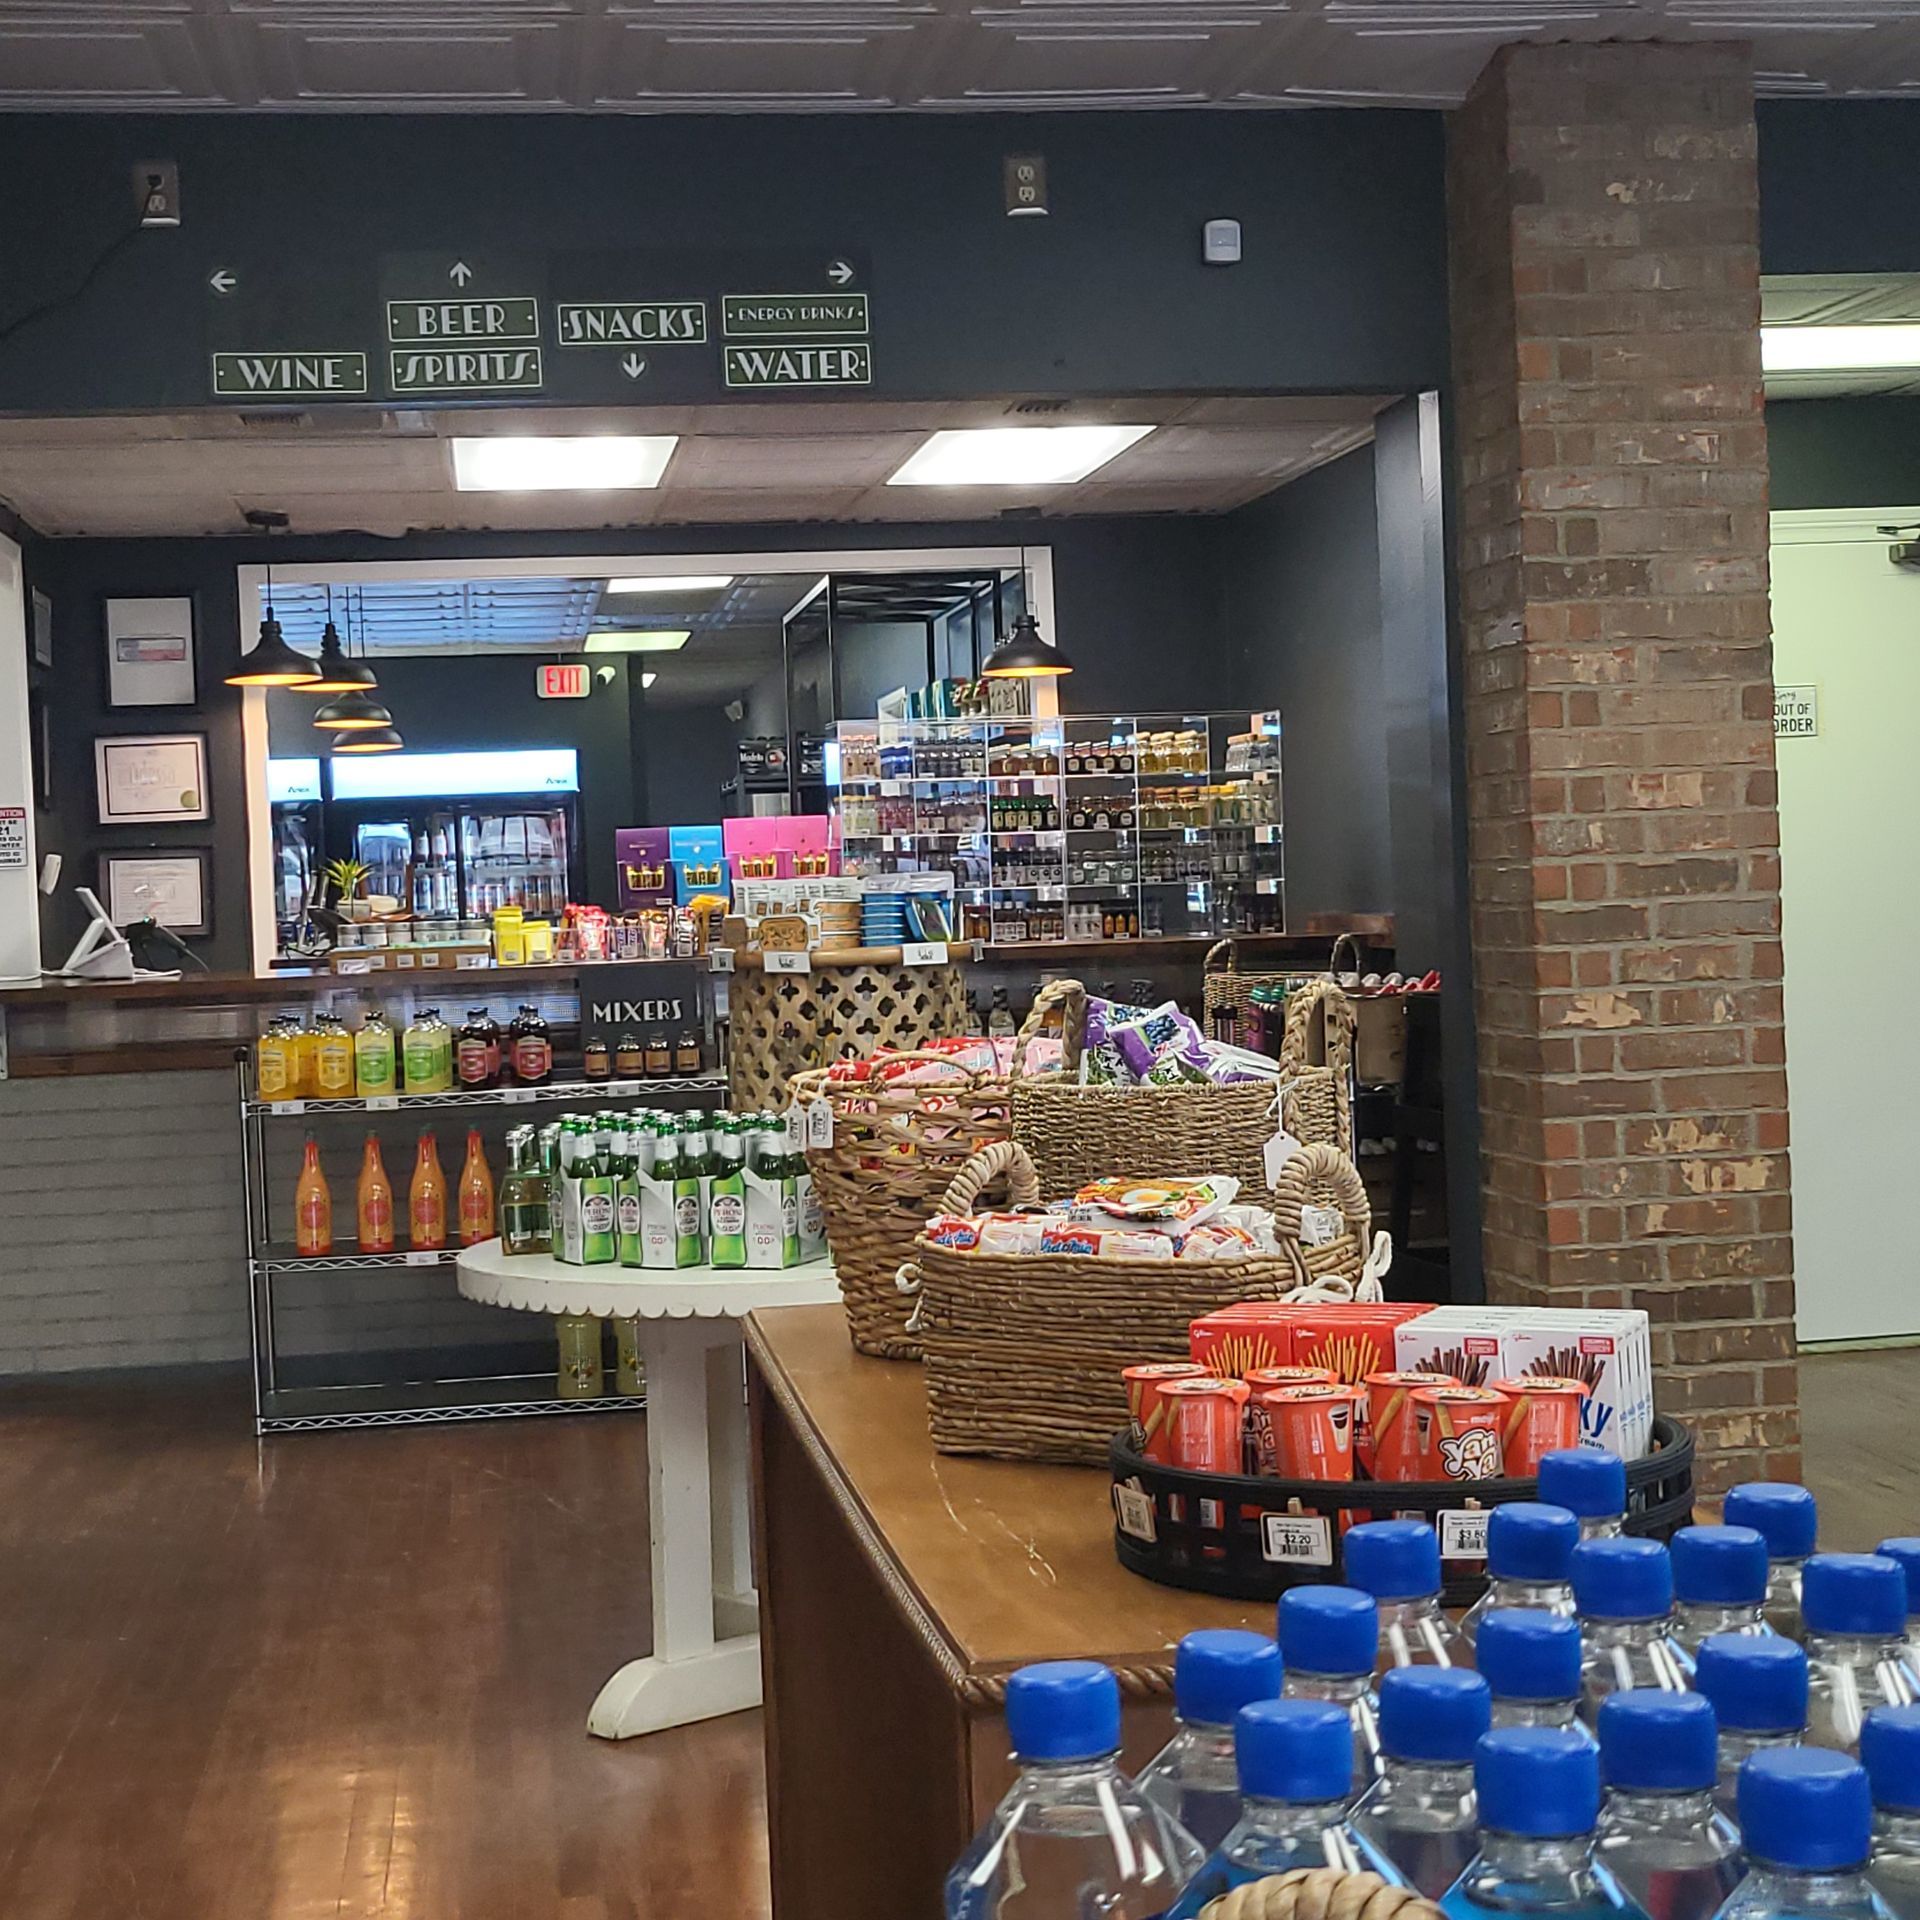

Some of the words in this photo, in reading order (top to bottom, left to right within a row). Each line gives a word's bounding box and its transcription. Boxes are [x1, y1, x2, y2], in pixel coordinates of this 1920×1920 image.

[418, 304, 505, 335] BEER
[568, 308, 694, 339] SNACKS
[739, 307, 796, 321] ENERGY
[800, 306, 855, 320] DRINKS
[237, 358, 344, 389] WINE
[400, 353, 532, 384] SPIRITS
[736, 350, 860, 381] WATER
[545, 666, 582, 694] EXIT
[1774, 704, 1794, 715] OUT
[1797, 703, 1811, 714] OF
[1774, 718, 1813, 732] ORDER
[593, 1000, 682, 1023] MIXERS
[1578, 1436, 1605, 1450] ream
[1285, 1533, 1311, 1544] $2.20
